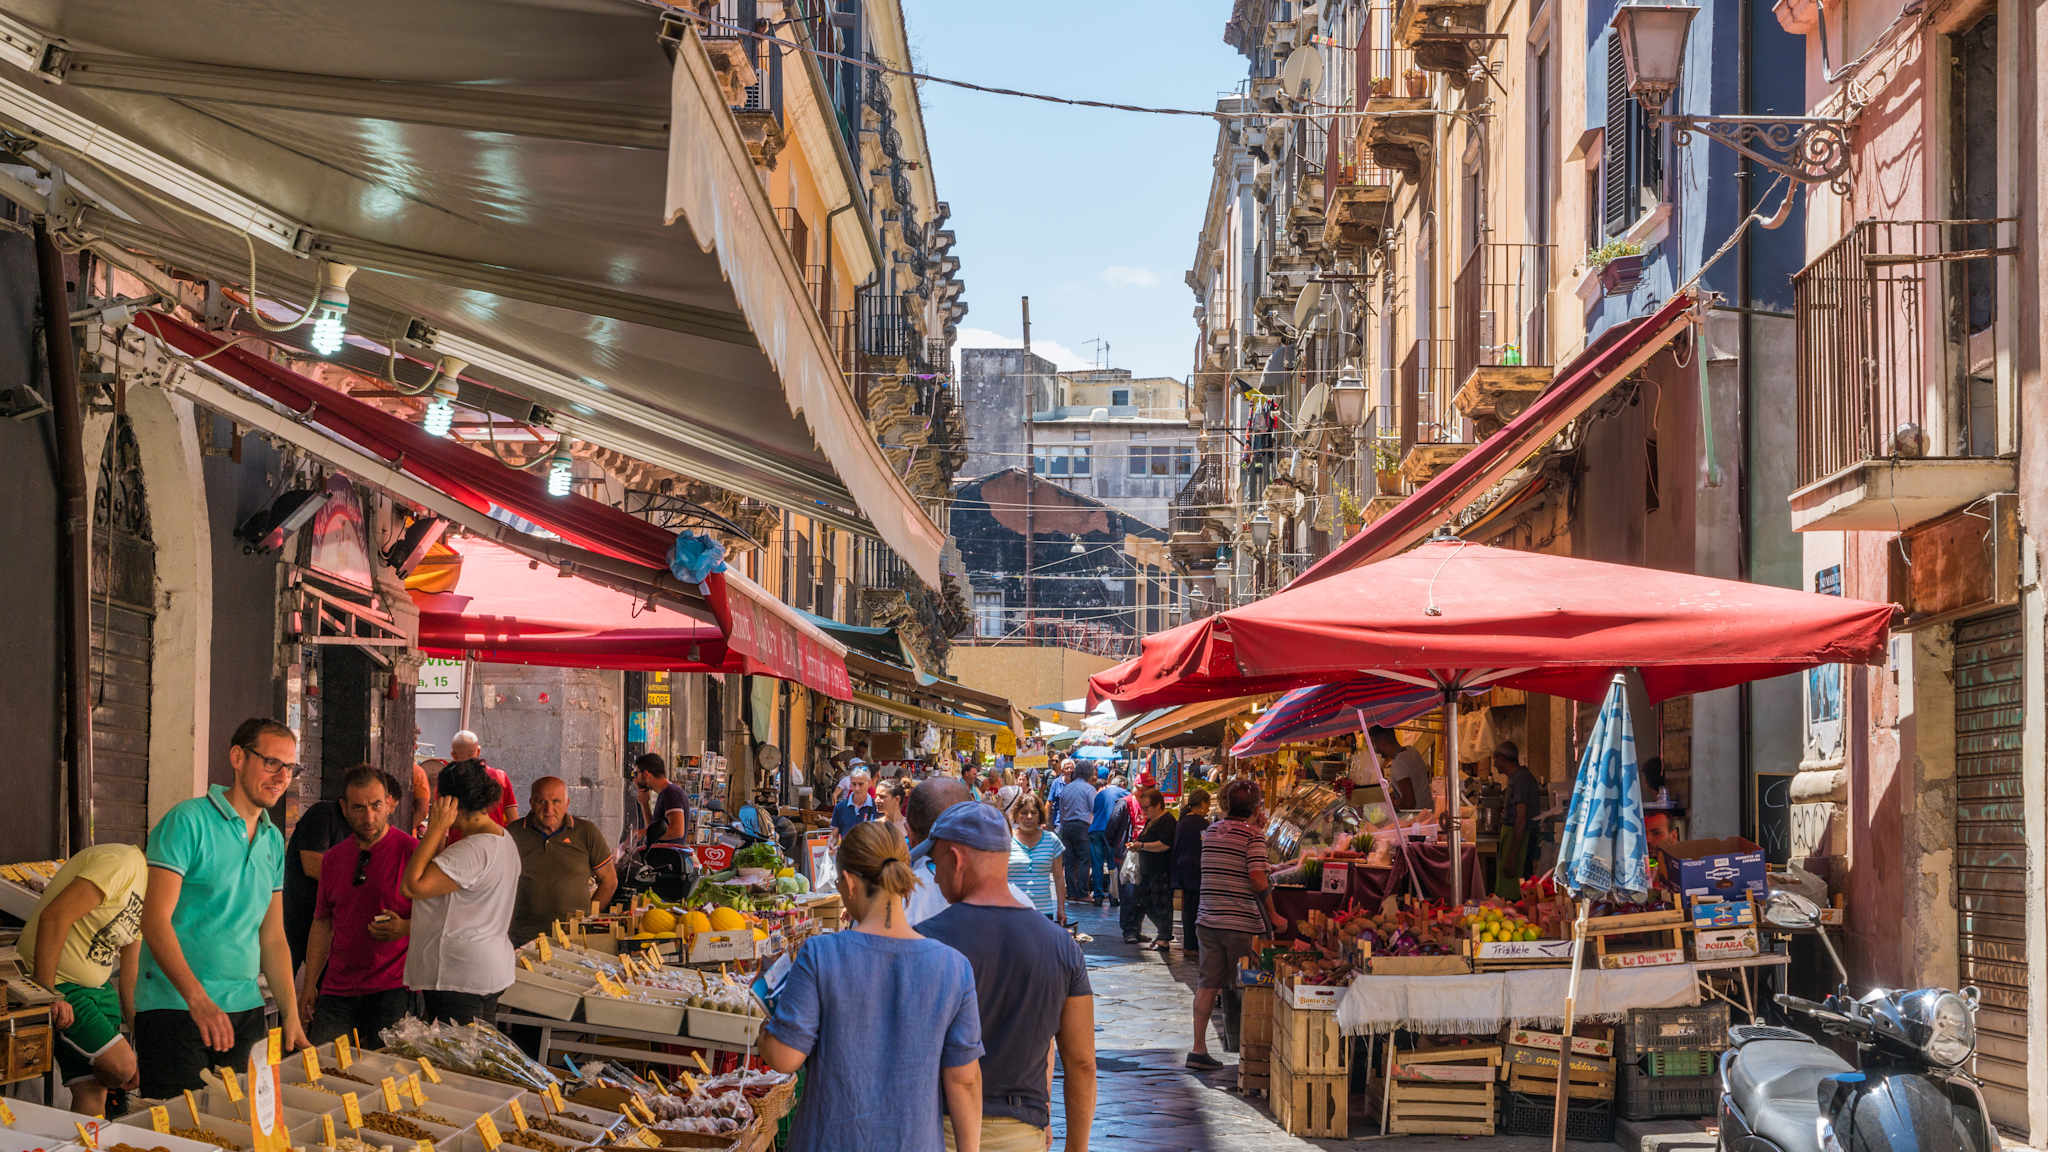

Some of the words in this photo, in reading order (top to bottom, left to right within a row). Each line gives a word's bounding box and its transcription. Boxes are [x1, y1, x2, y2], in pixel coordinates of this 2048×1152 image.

[433, 676, 449, 688] 15
[1623, 955, 1635, 966] Le
[1637, 954, 1657, 965] Due
